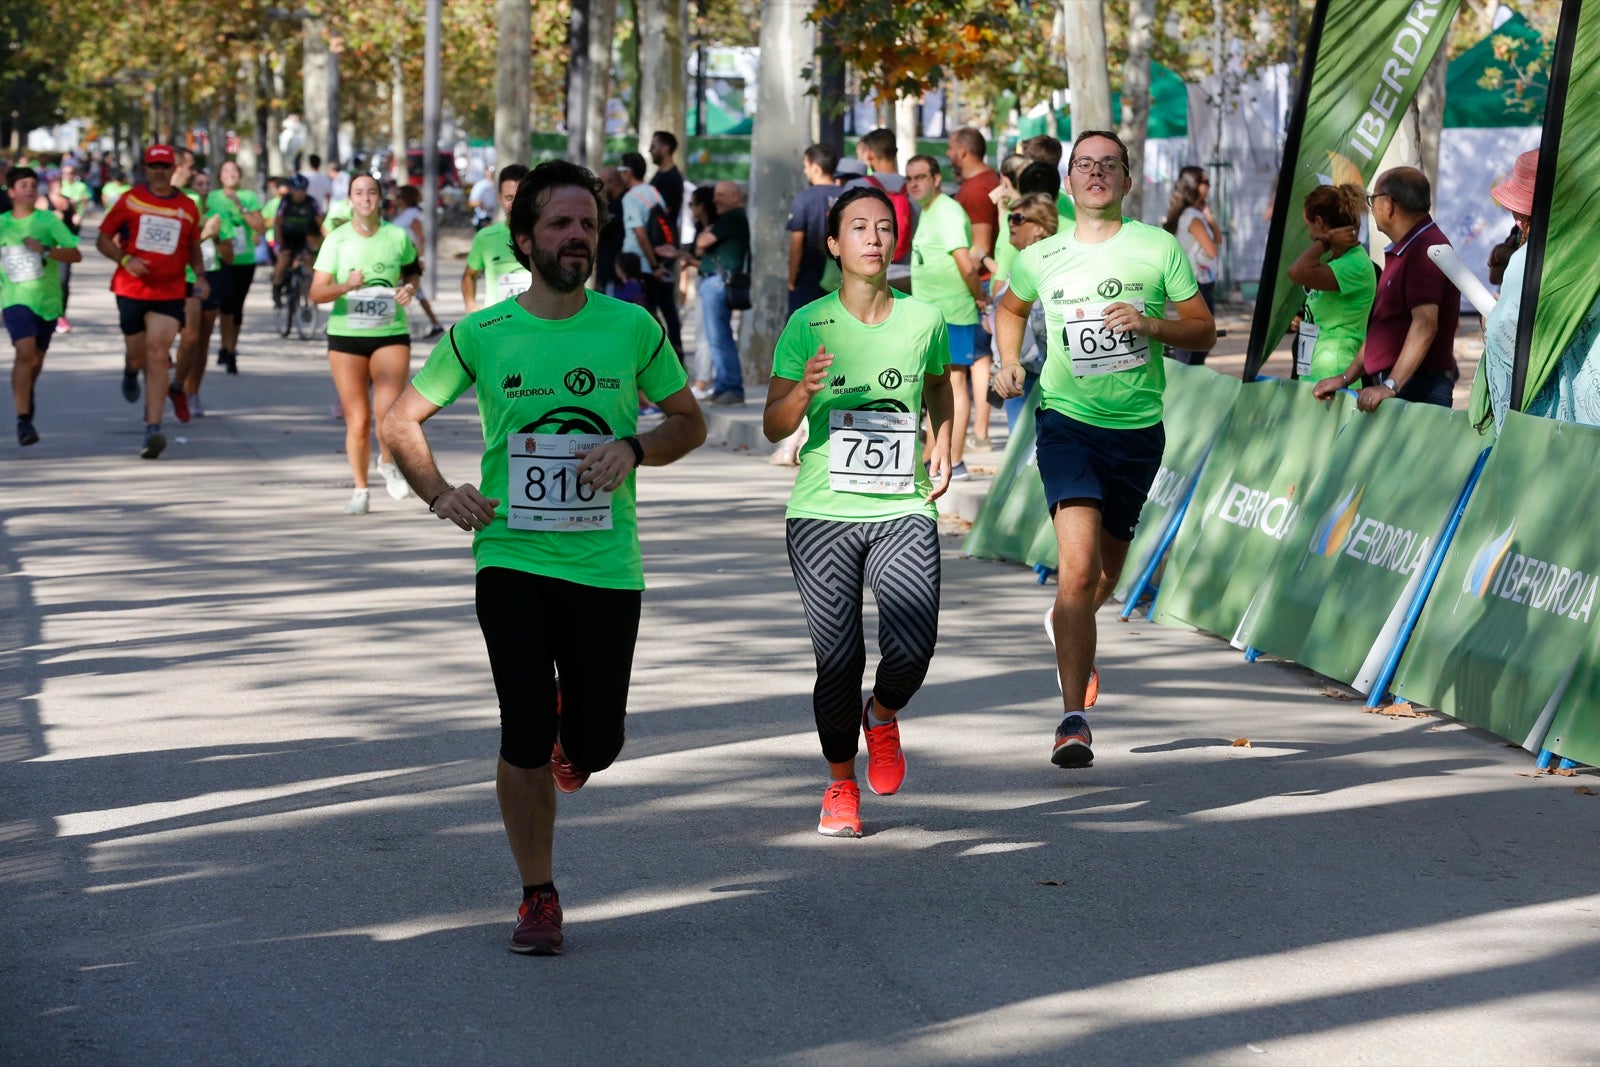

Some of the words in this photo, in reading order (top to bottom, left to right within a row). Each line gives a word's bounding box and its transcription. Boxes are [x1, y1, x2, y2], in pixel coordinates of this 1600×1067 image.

[354, 300, 388, 317] 482
[1080, 326, 1137, 355] 634
[506, 388, 555, 399] IBERDROLA
[832, 384, 872, 395] IBERDROLA
[843, 437, 900, 470] 751
[525, 466, 596, 503] 816
[1491, 550, 1600, 624] IBERDROLA
